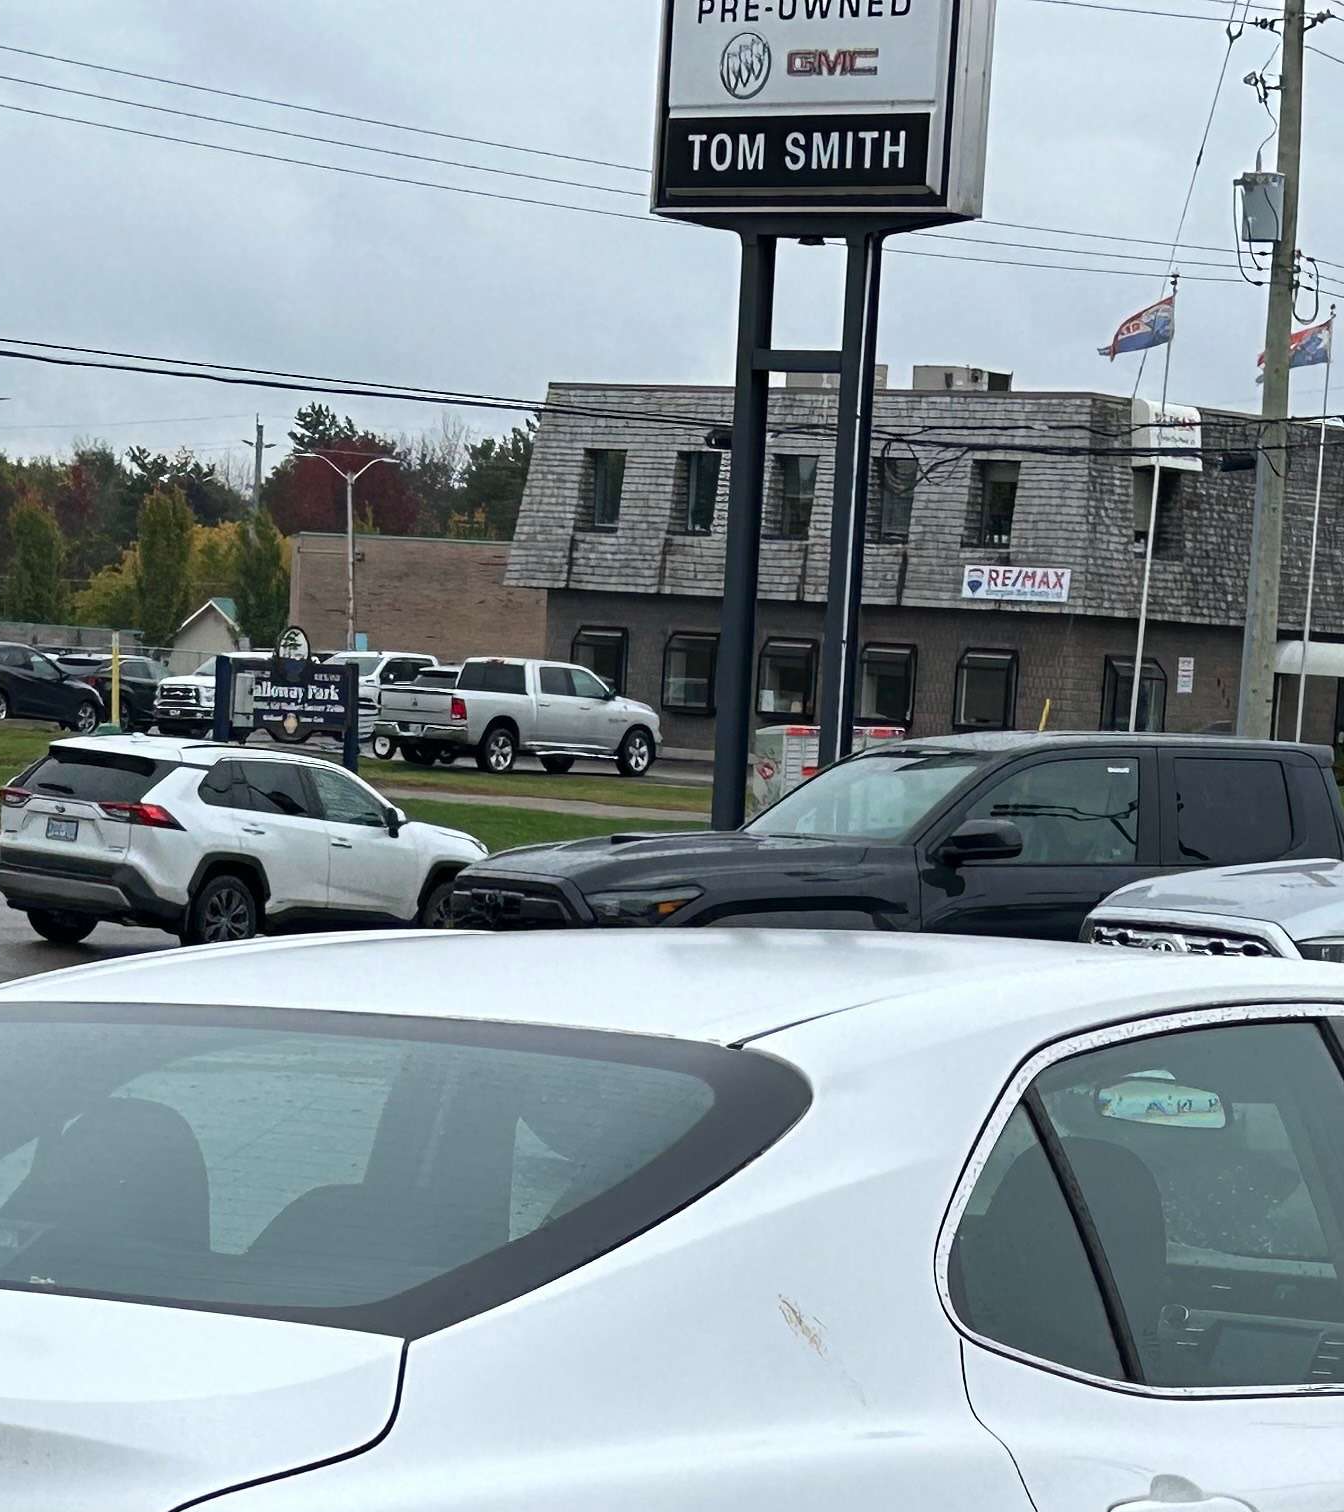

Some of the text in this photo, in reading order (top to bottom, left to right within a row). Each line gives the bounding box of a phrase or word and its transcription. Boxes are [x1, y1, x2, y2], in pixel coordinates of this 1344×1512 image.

[787, 48, 879, 77] GMC
[687, 130, 906, 171] TOM SMITH
[987, 568, 1065, 590] RE/MAX
[253, 681, 339, 703] alloway Park
